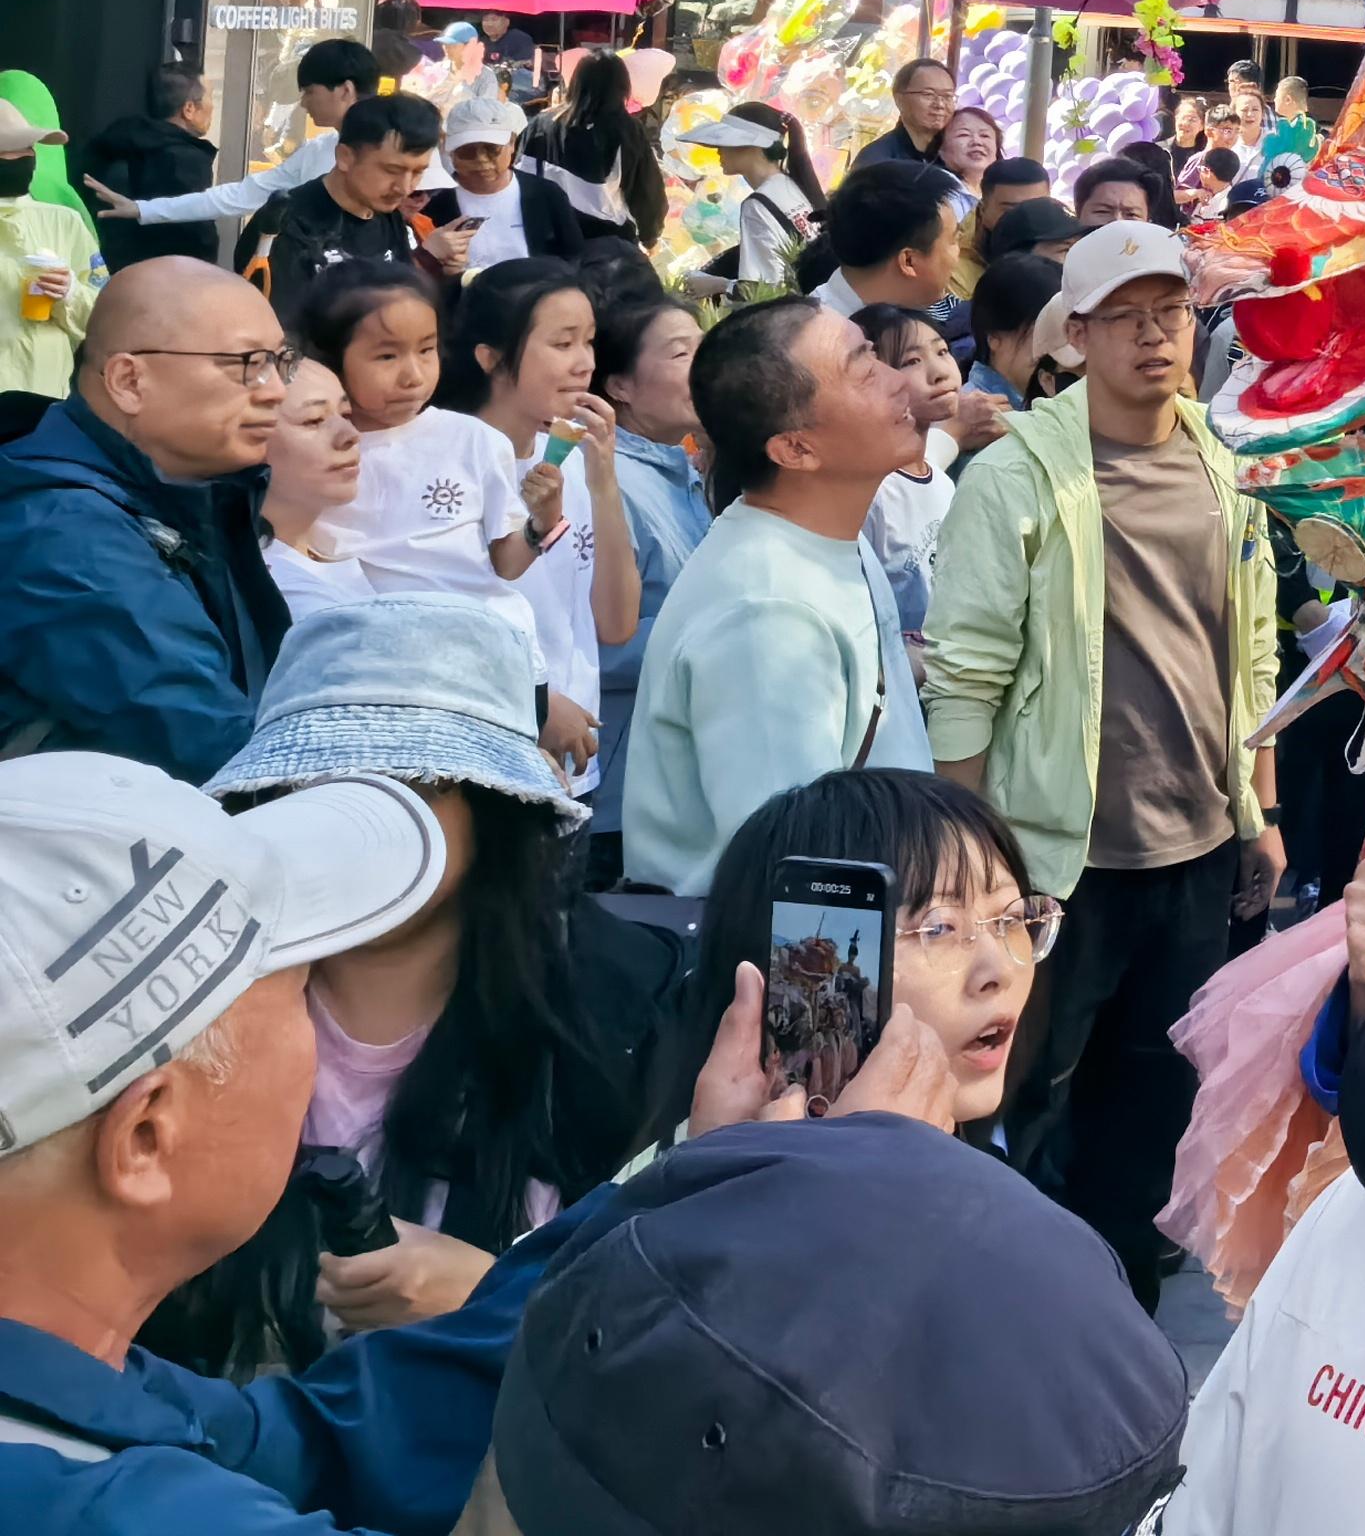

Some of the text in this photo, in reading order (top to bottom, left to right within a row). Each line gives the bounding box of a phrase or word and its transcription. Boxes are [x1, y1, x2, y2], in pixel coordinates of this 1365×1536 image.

[281, 7, 318, 30] LIGHT
[319, 8, 358, 30] BITES
[91, 880, 185, 979] NEW
[105, 906, 240, 1041] YORK
